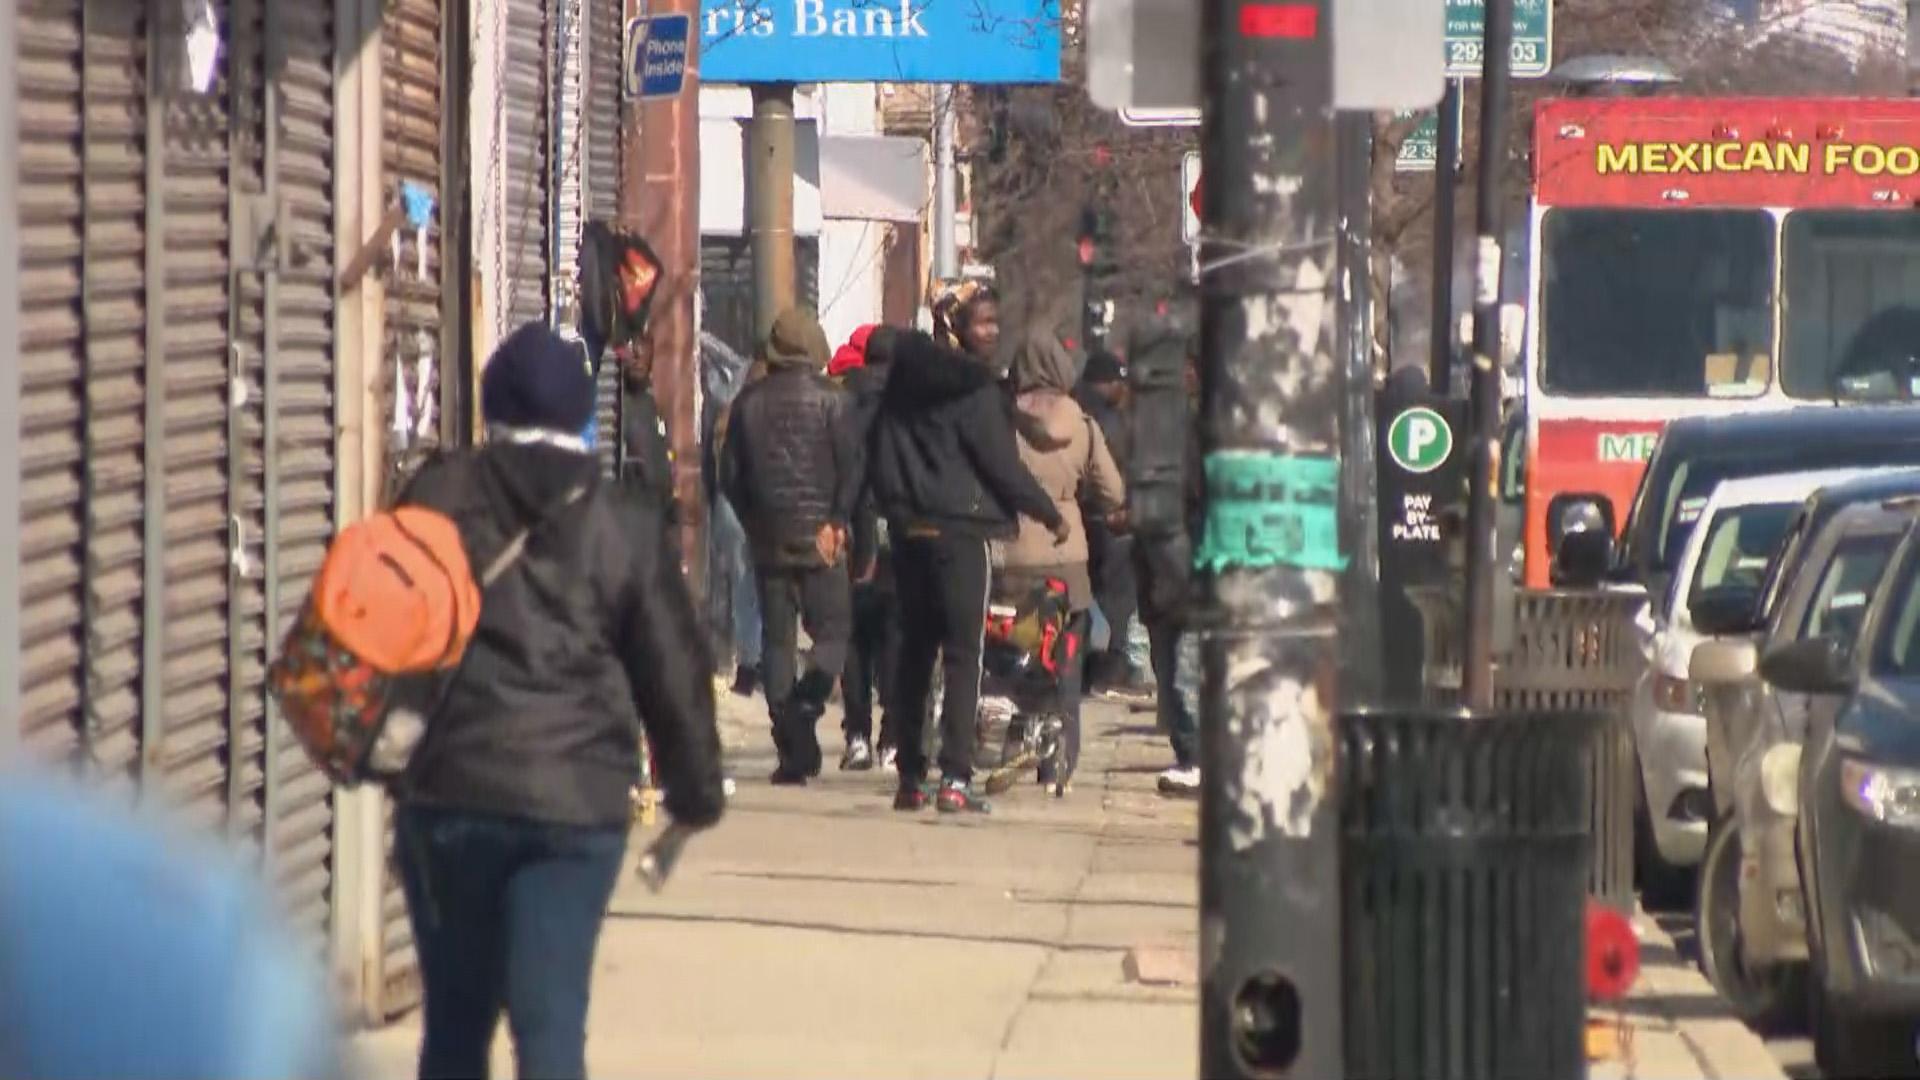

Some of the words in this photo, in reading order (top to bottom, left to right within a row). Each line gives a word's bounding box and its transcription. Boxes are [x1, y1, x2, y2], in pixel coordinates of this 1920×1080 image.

[790, 0, 929, 37] Bank
[647, 40, 685, 55] Phone
[644, 60, 683, 78] Inside
[1597, 142, 1809, 174] MEXICAN
[1823, 144, 1920, 175] FOO
[1404, 495, 1432, 510] PAY
[1393, 525, 1441, 540] PLATE
